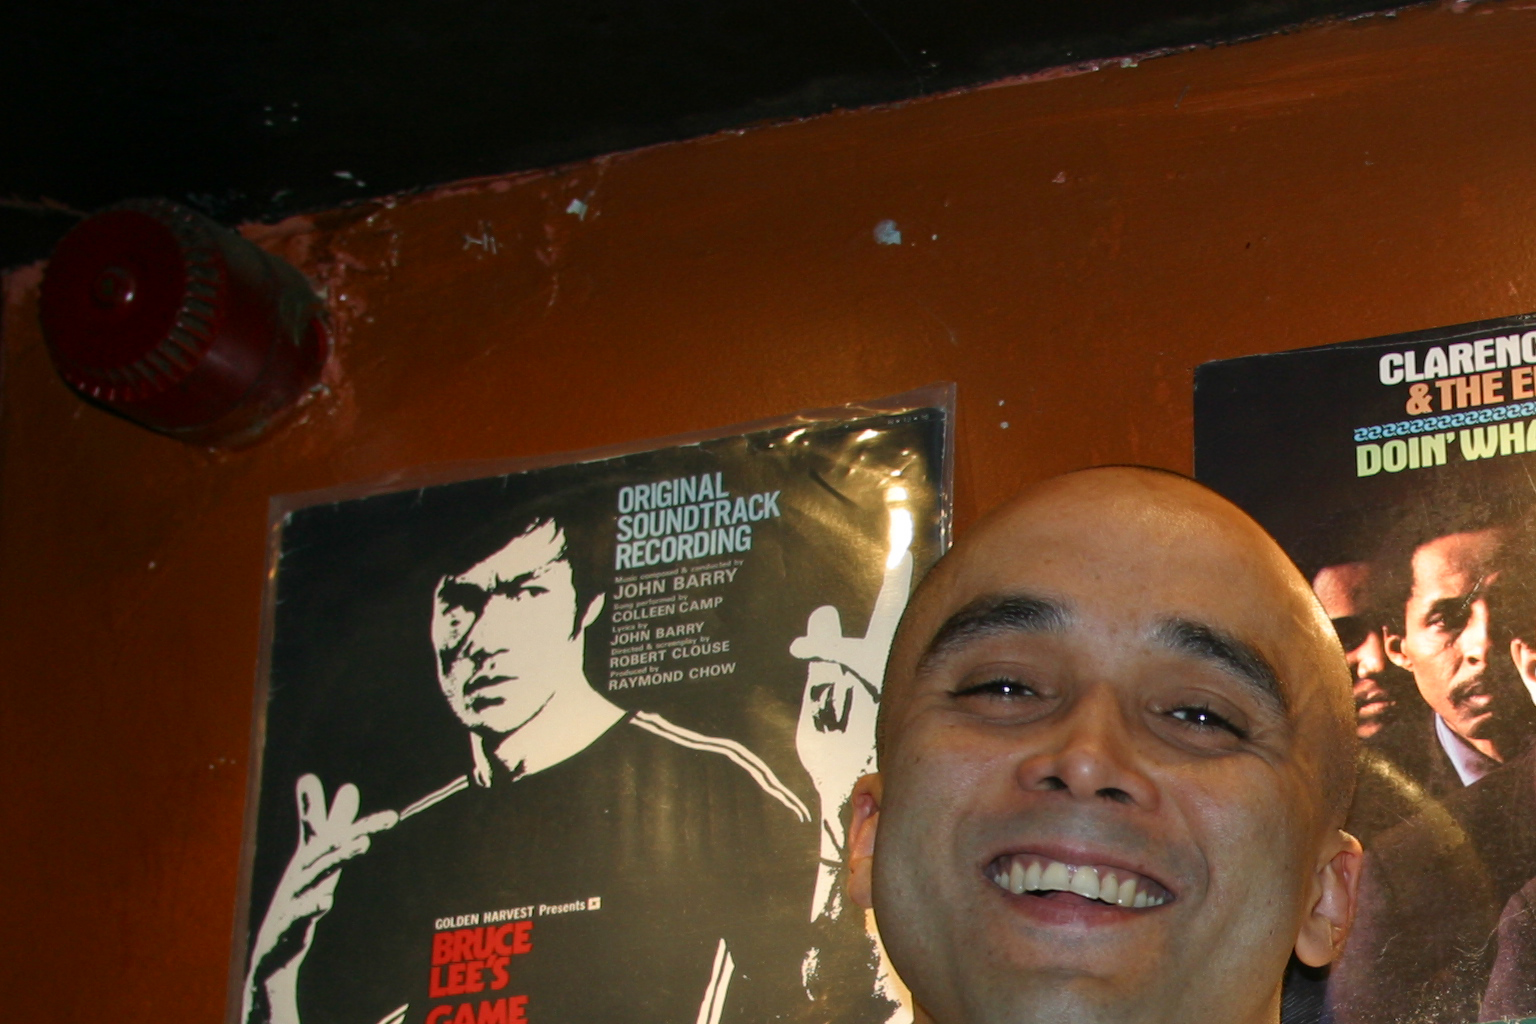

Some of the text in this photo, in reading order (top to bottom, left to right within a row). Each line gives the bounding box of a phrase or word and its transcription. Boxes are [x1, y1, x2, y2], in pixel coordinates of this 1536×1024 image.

[1405, 383, 1433, 415] &
[1436, 371, 1505, 411] THE
[1355, 431, 1454, 477] DOIN'
[618, 472, 729, 514] ORIGINAL
[616, 490, 781, 542] SOUNDTRACK
[615, 525, 752, 570] RECORDING
[734, 559, 744, 567] by
[613, 568, 738, 600] JOHN BARRY
[612, 596, 723, 623] COLLEEN CAMP
[610, 622, 705, 646] JOHN BARRY
[638, 622, 649, 630] by
[610, 640, 730, 668] ROBERT CLOUSE
[649, 665, 660, 673] by
[608, 662, 736, 691] RAYMOND CHOW
[435, 900, 586, 930] GOLDEN HARVEST Presents
[431, 920, 534, 967] BRUCE
[429, 955, 511, 998] LEE'S
